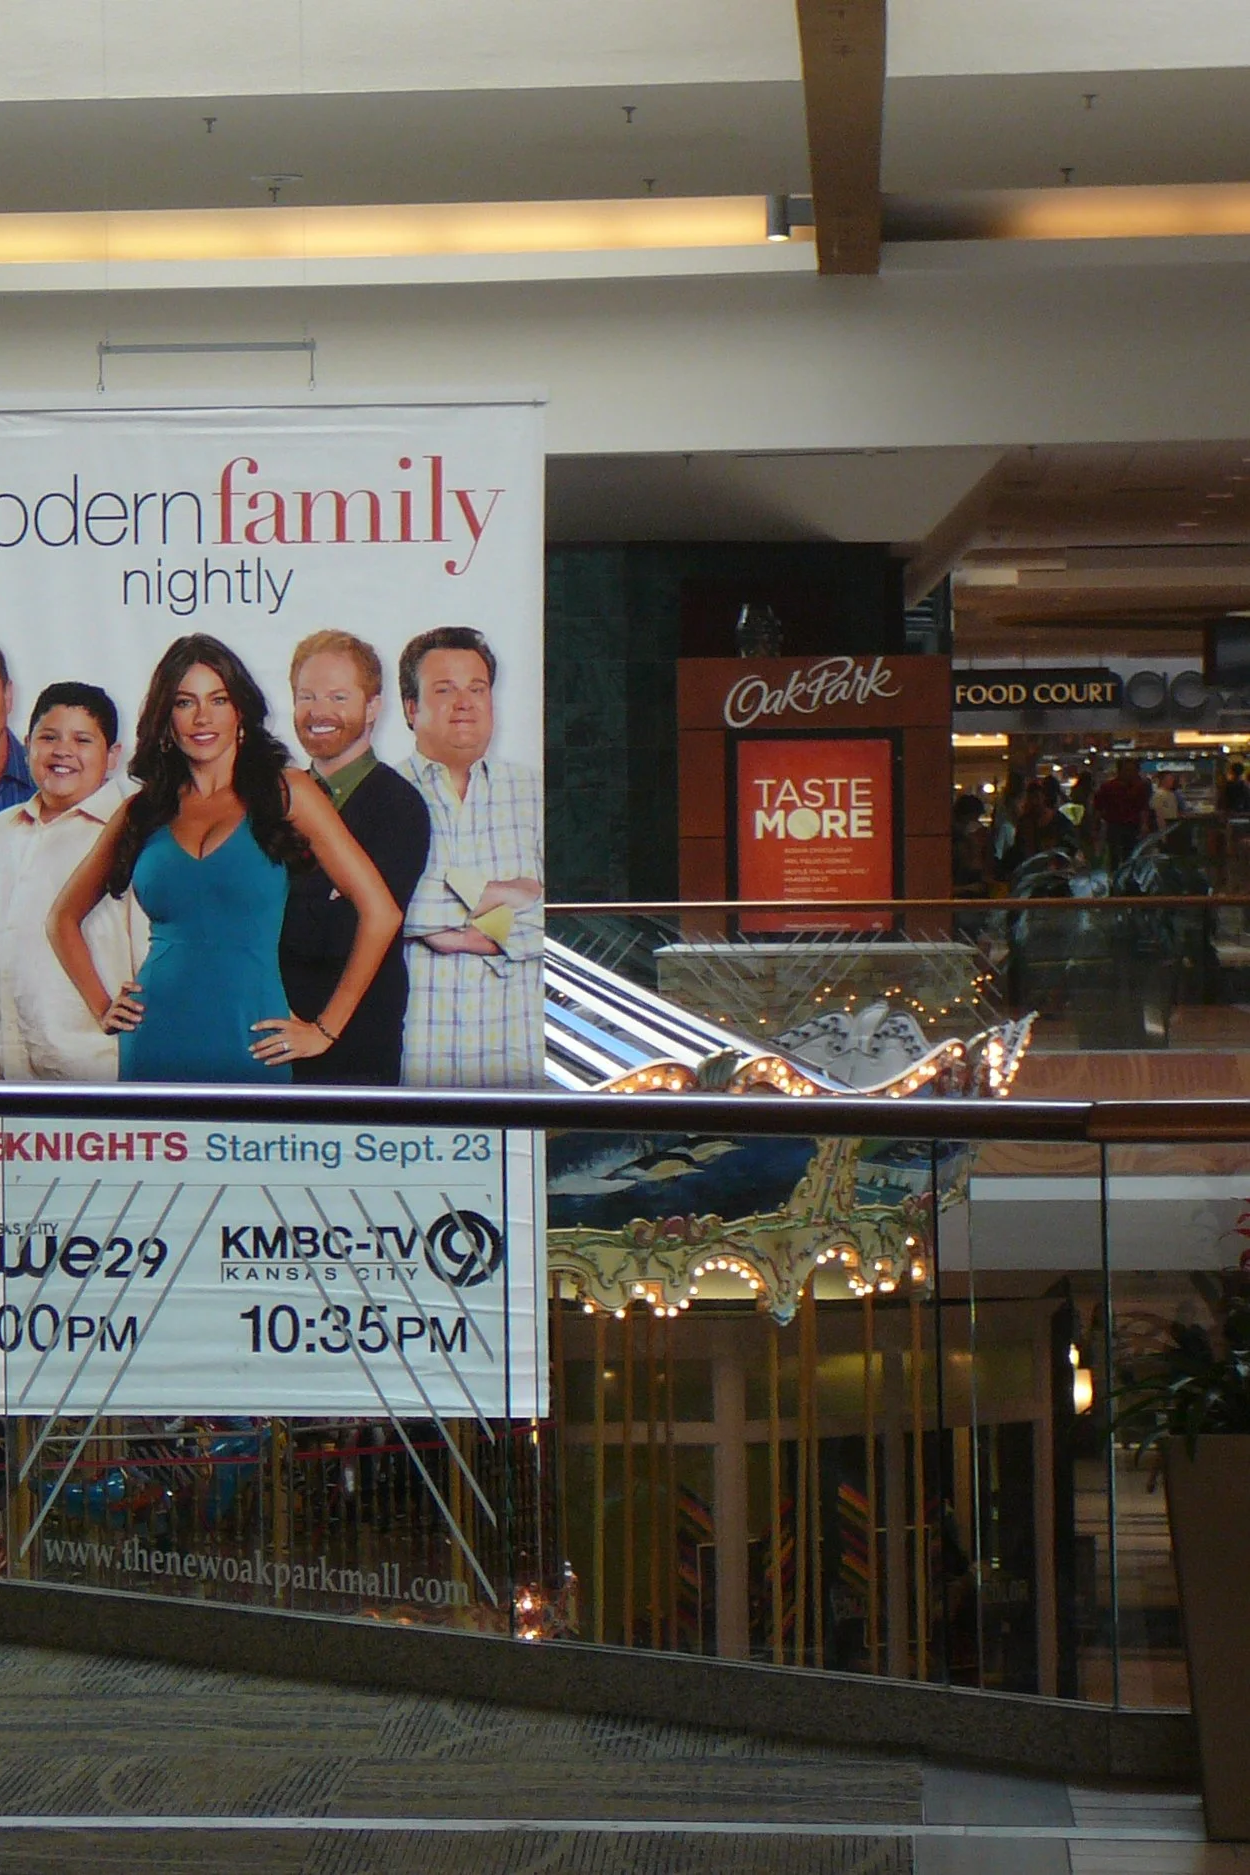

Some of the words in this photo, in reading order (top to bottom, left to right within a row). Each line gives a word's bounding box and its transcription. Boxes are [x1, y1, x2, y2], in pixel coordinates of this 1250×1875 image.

[123, 557, 294, 615] nightly
[724, 670, 820, 728] Oak
[807, 655, 902, 707] Park
[955, 684, 1027, 705] FOOD
[1033, 682, 1118, 704] COURT
[754, 778, 873, 808] TASTE
[754, 808, 873, 840] MORE
[206, 1133, 342, 1169] Starting
[354, 1134, 444, 1168] Sept.
[451, 1134, 492, 1162] 23
[221, 1225, 419, 1260] KMBC-TV
[354, 1267, 418, 1282] CITY
[44, 1536, 470, 1607] www.thenewoakparkmall.com
